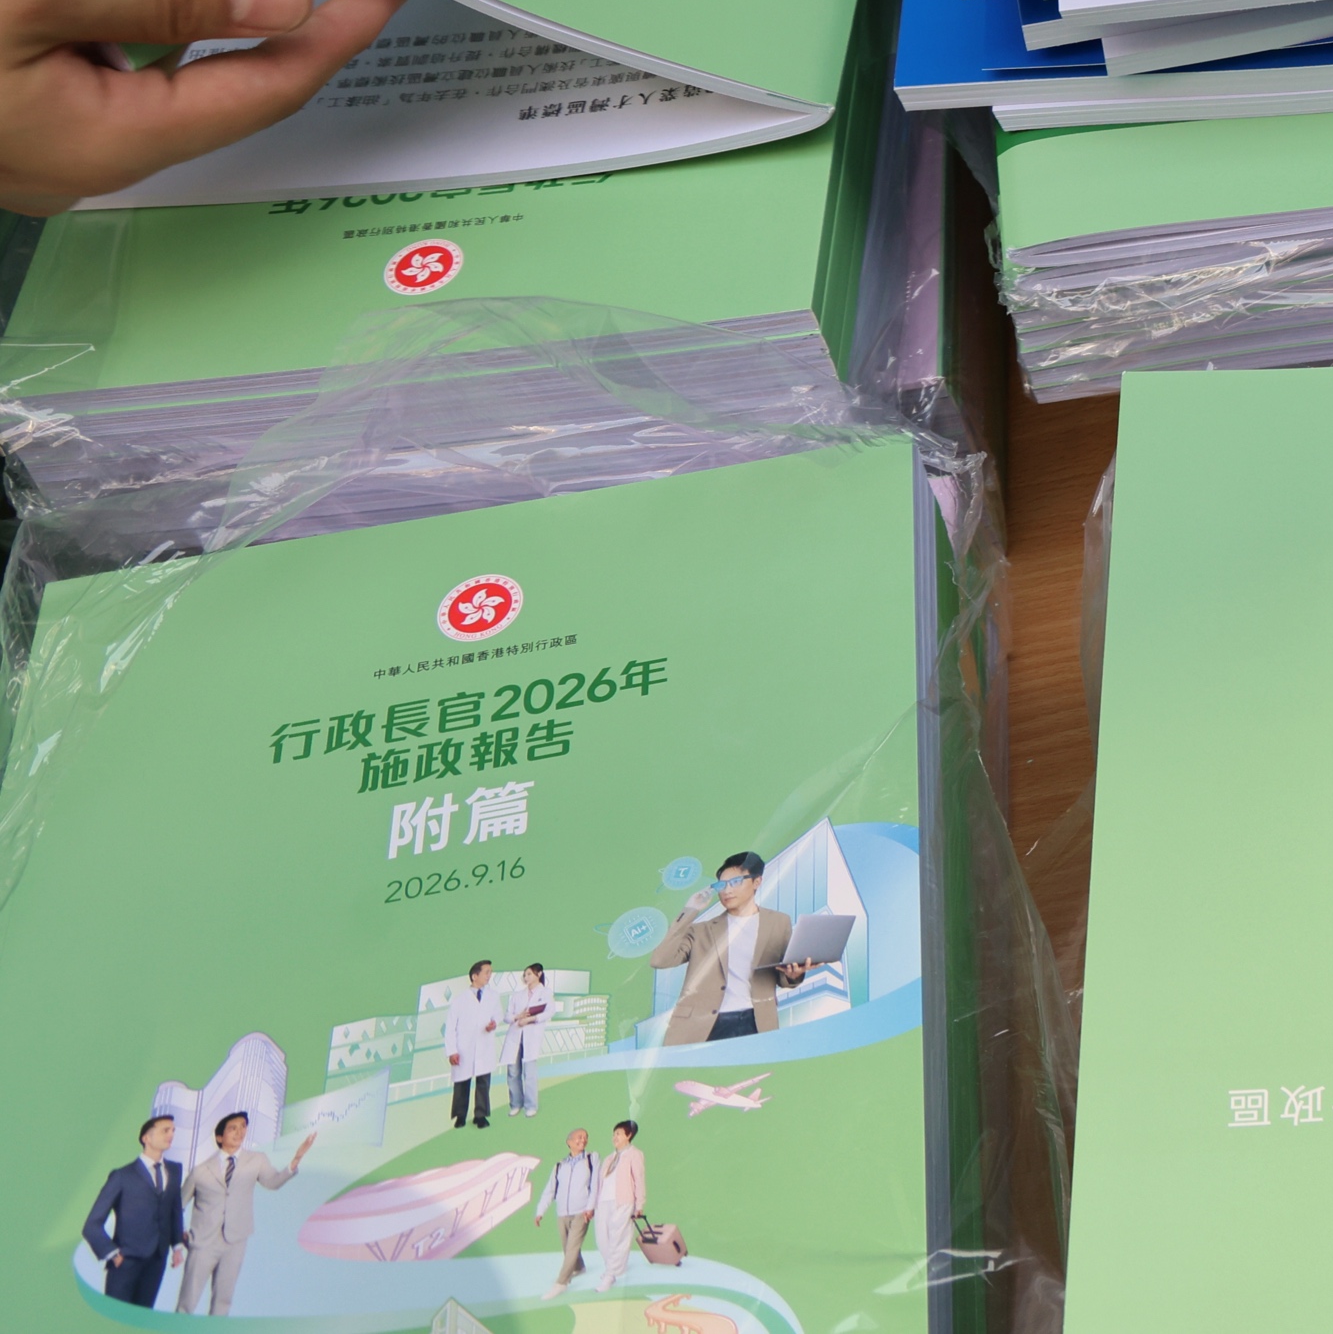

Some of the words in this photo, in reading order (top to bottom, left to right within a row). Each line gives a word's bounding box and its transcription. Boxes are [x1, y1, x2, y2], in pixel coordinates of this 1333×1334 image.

[518, 84, 714, 121] 造業人才灣區標準
[373, 633, 579, 681] 中華人民共和國香港特別行政區
[269, 656, 671, 765] 行政長官2026年
[356, 718, 576, 795] 施政報告
[386, 780, 536, 861] 附篇
[384, 856, 527, 906] 2026.9.16
